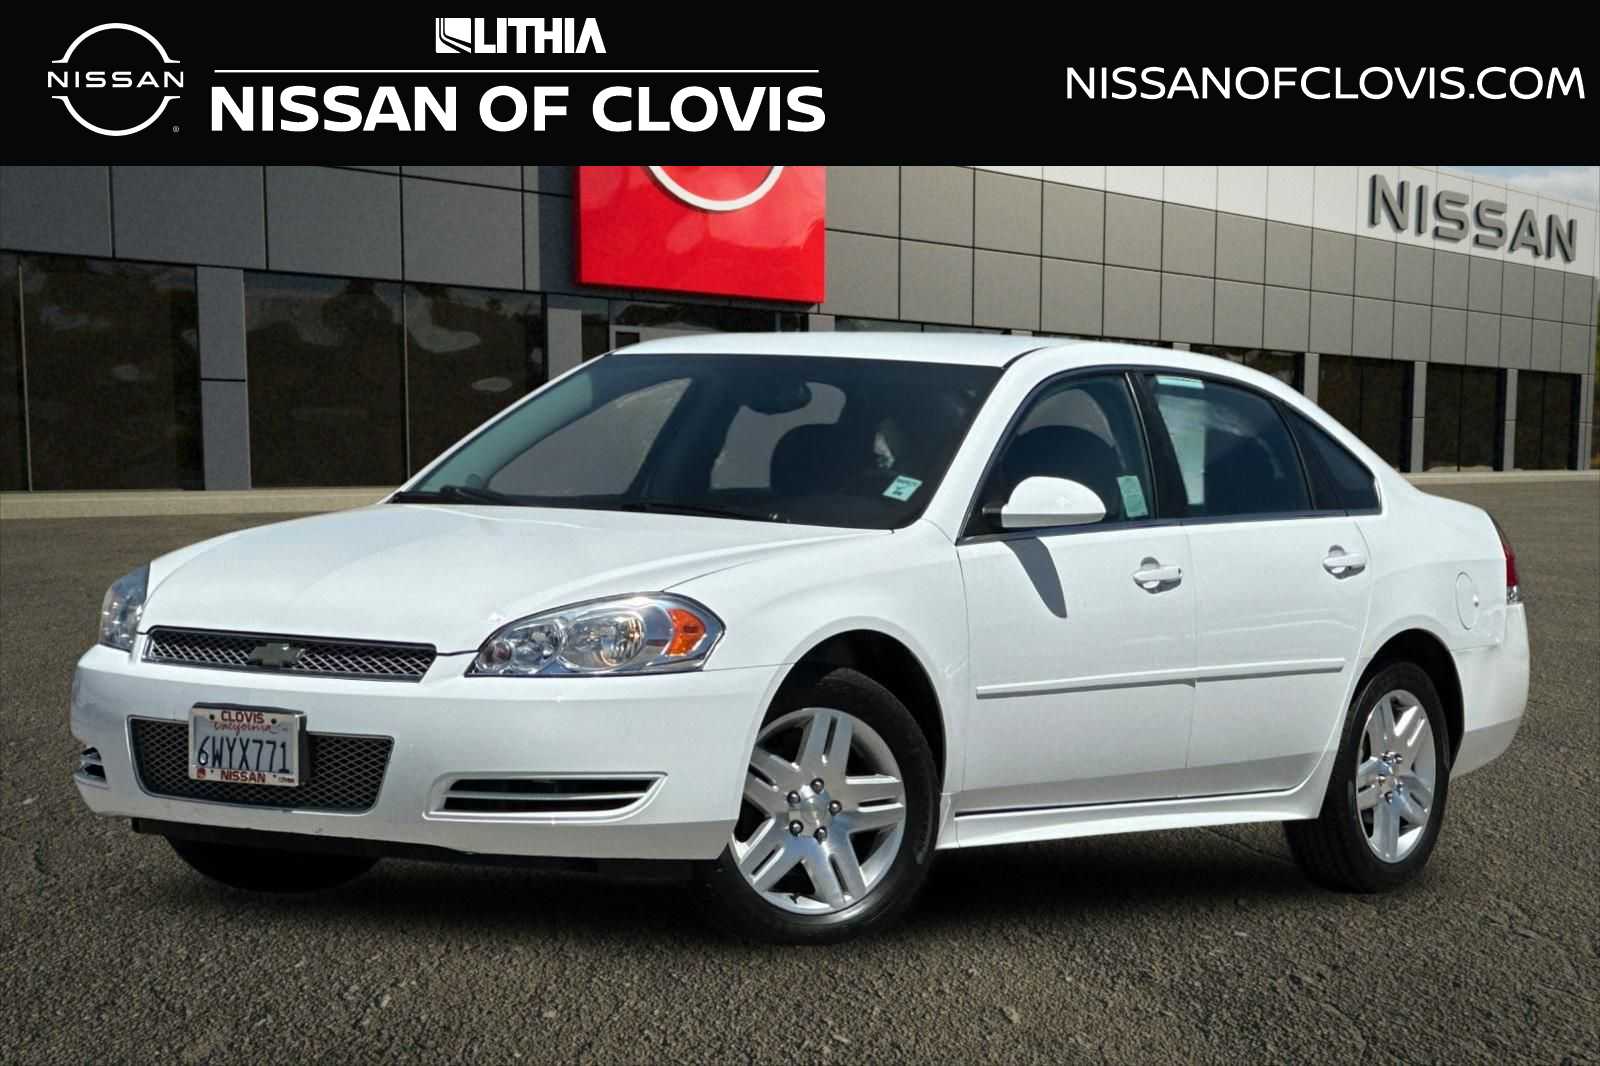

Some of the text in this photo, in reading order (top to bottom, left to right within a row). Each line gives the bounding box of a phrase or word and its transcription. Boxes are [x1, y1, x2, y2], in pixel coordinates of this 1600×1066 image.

[1368, 174, 1577, 263] NISSAN
[221, 711, 265, 724] CLOVIS
[198, 735, 290, 773] 6WYX771
[221, 770, 266, 783] NISSAN
